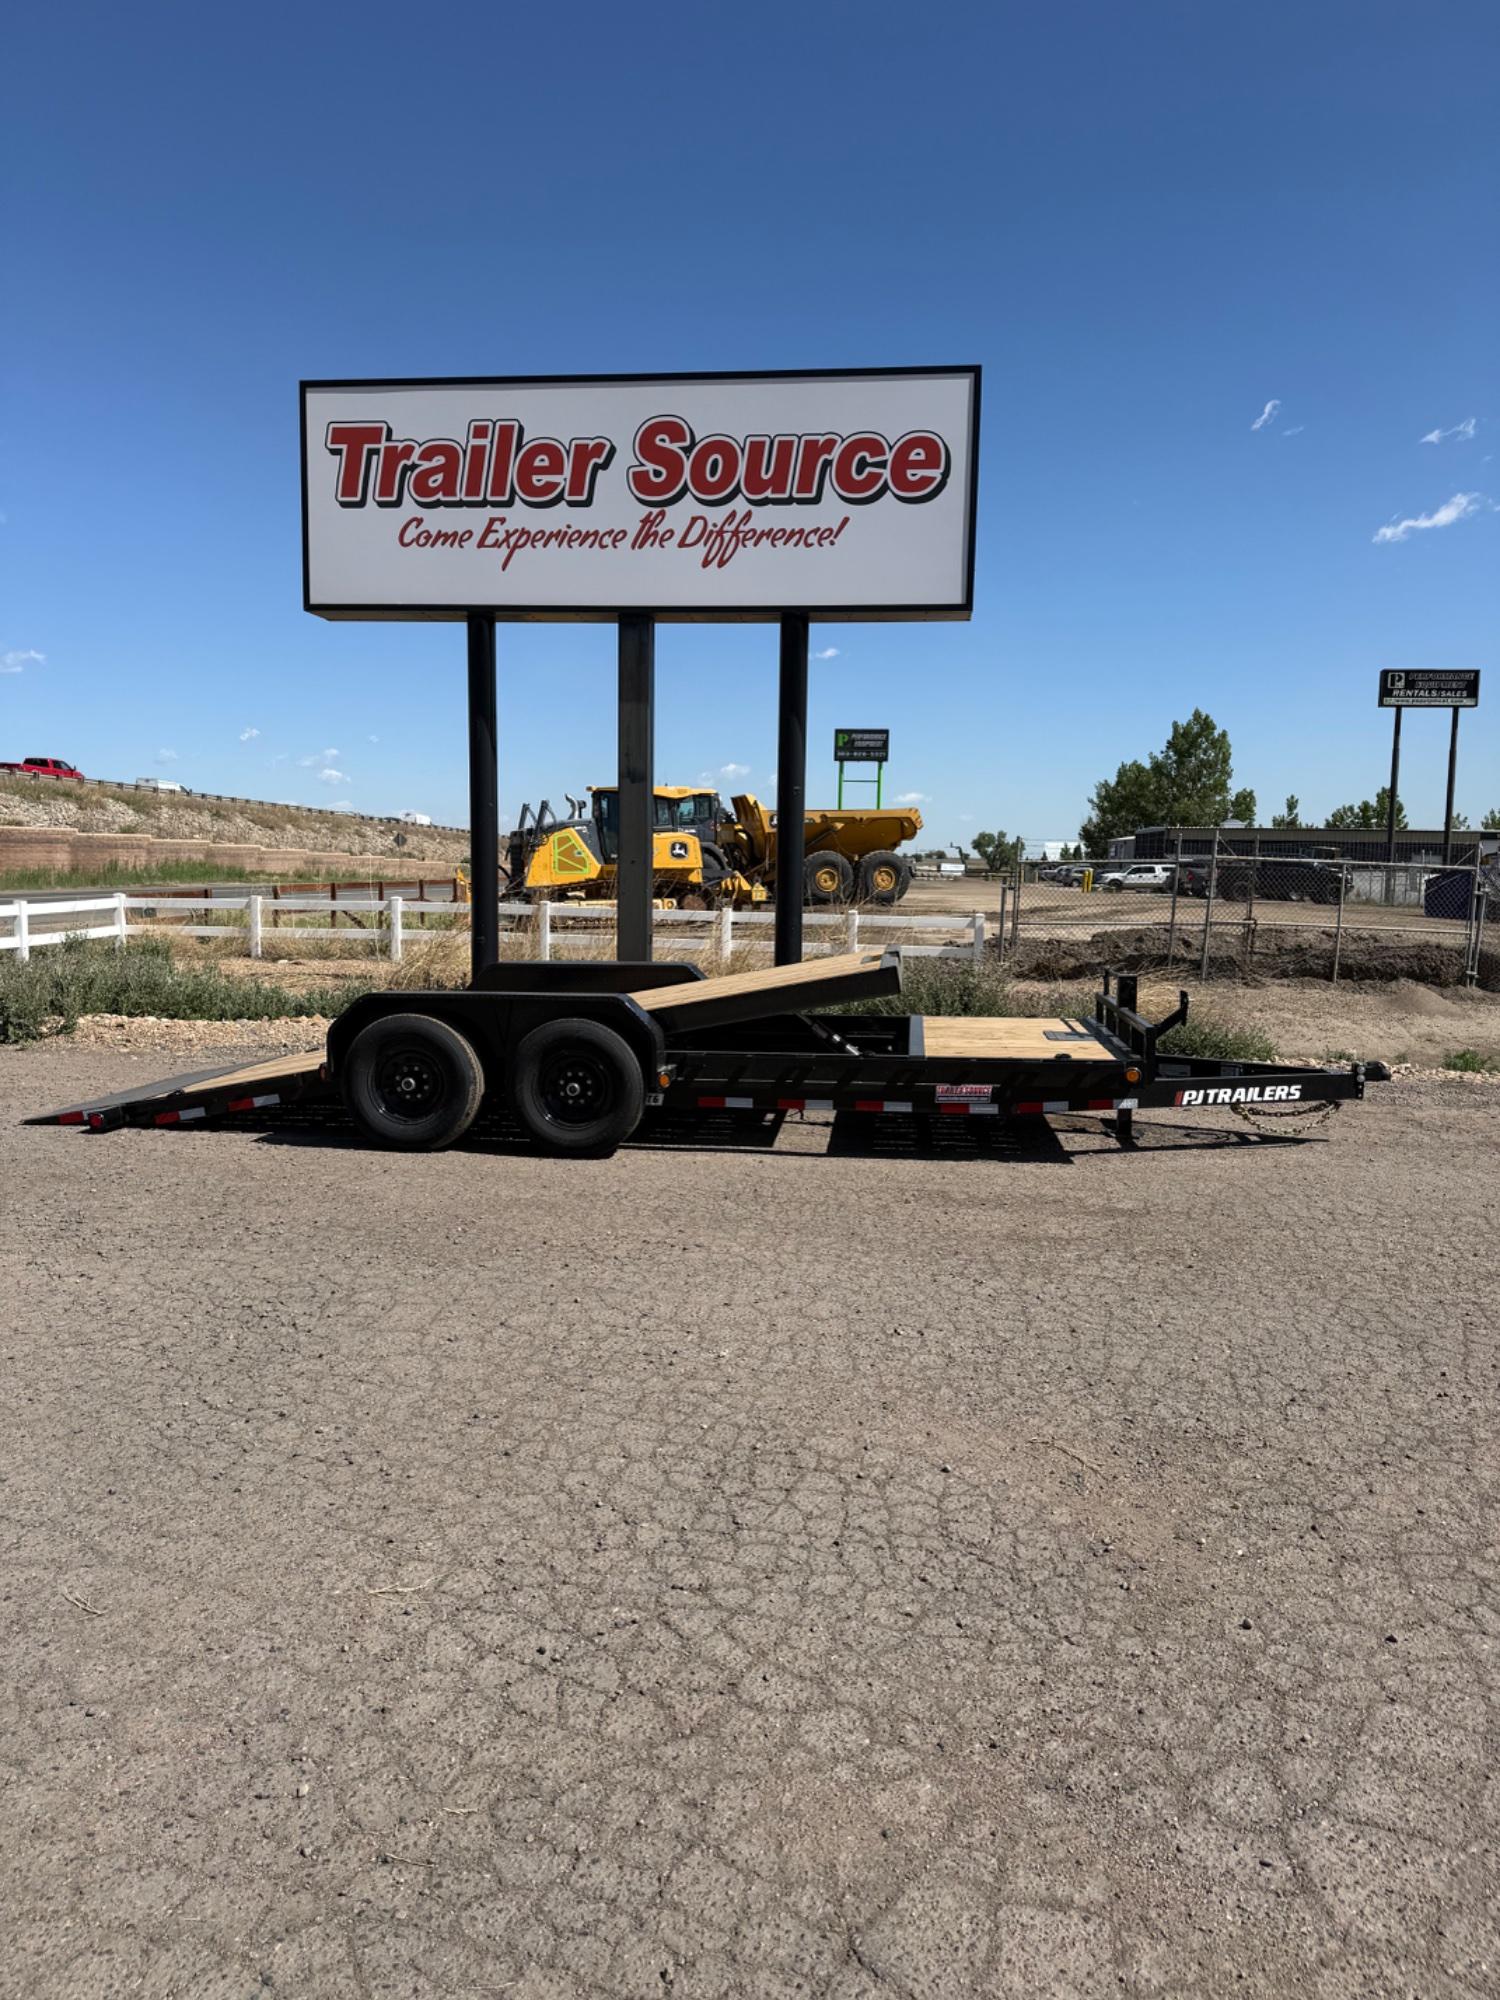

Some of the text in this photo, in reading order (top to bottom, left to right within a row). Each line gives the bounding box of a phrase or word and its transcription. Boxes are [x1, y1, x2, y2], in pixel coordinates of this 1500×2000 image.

[325, 415, 951, 508] Trailer Source
[398, 516, 474, 548] Come
[476, 516, 628, 572] Experience
[677, 509, 850, 569] Difference!
[1206, 1084, 1302, 1103] TRAILERS
